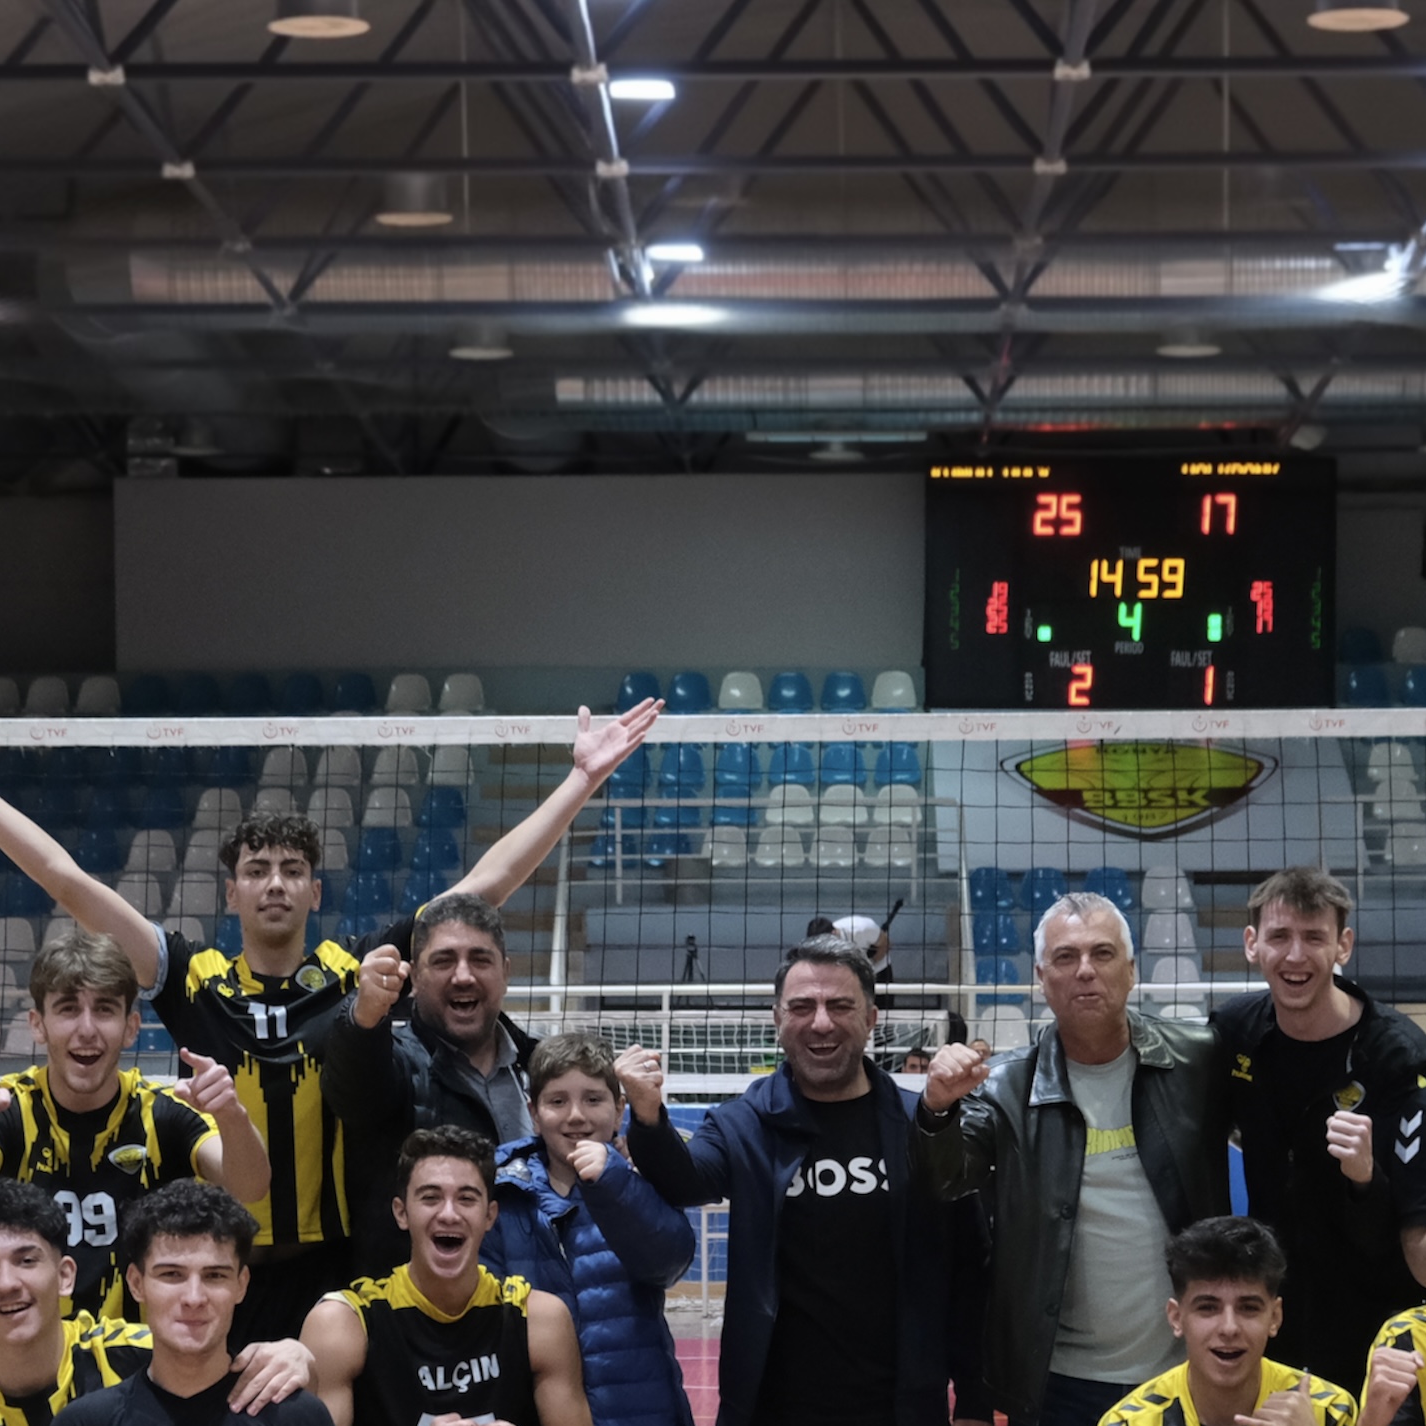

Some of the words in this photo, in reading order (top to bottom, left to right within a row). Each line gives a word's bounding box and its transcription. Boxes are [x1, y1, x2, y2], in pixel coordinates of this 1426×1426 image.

[1033, 492, 1083, 536] 25
[1200, 492, 1237, 536] 17
[1118, 601, 1142, 642] 4
[1115, 642, 1144, 654] PERIOD
[1049, 650, 1092, 668] FAUL/SET
[1170, 649, 1213, 668] FAUL/SET
[1068, 663, 1094, 706] 2
[1202, 664, 1215, 706] 1
[743, 723, 765, 734] TVF
[857, 722, 879, 733] TVF
[976, 721, 997, 732] TVF
[1209, 719, 1230, 730] TVF
[1325, 718, 1345, 729] TVF
[47, 727, 69, 738] TVF
[163, 726, 185, 737] TVF
[393, 725, 416, 737] TVF
[509, 725, 532, 736] TVF
[1082, 789, 1212, 808] BBSK
[247, 1002, 288, 1040] 11
